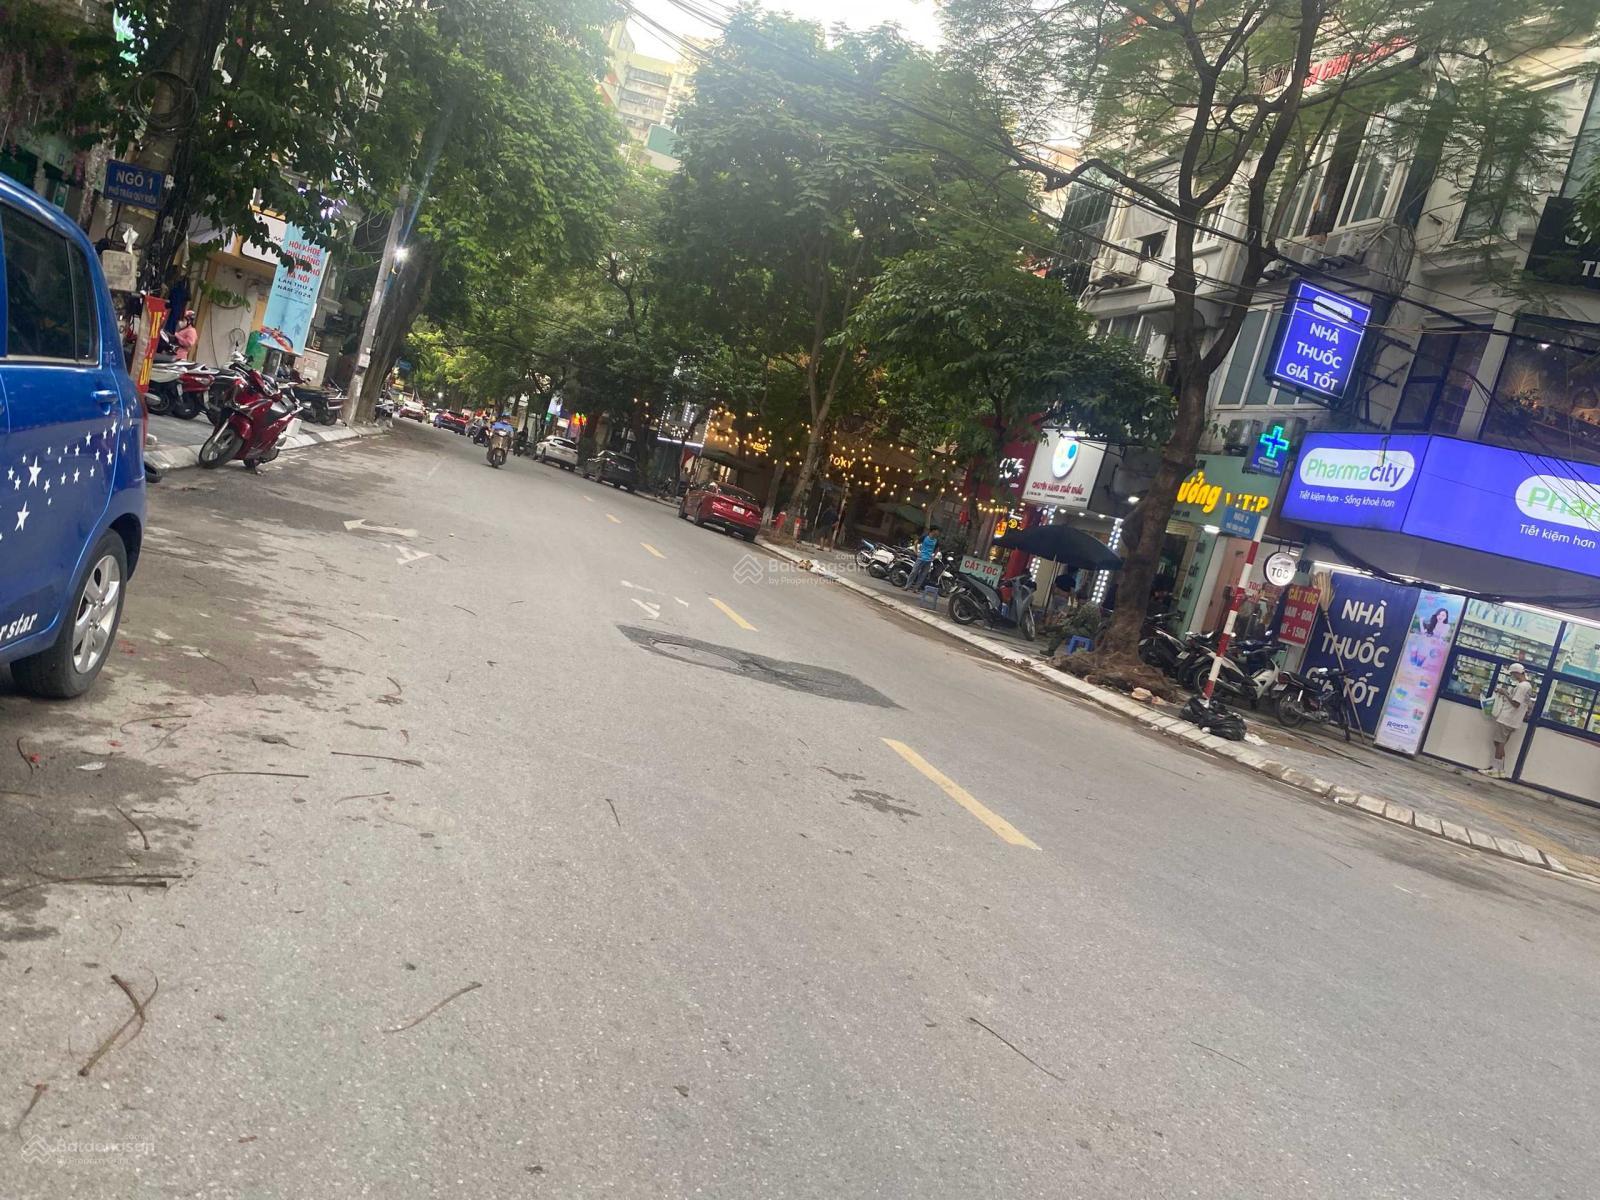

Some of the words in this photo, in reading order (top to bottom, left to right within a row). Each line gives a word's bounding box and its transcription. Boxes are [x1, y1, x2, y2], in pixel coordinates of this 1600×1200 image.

[147, 177, 153, 190] 1
[1309, 322, 1340, 344] NHÀ
[1296, 341, 1342, 369] THUỐC
[1286, 362, 1310, 381] GIÁ
[1313, 371, 1338, 391] TỐT
[1305, 457, 1405, 488] Pharmacity
[1298, 490, 1311, 500] Tiết
[1310, 491, 1326, 503] kiệm
[1326, 493, 1339, 502] hơn
[1344, 494, 1362, 508] Sống
[1381, 498, 1395, 508] hơn
[1519, 524, 1540, 537] Tiết
[1541, 528, 1570, 544] kiệm
[1573, 535, 1596, 549] hơn
[1341, 598, 1387, 628] NHÀ
[1321, 632, 1390, 668] THUỐC
[1343, 672, 1380, 708] TỐT
